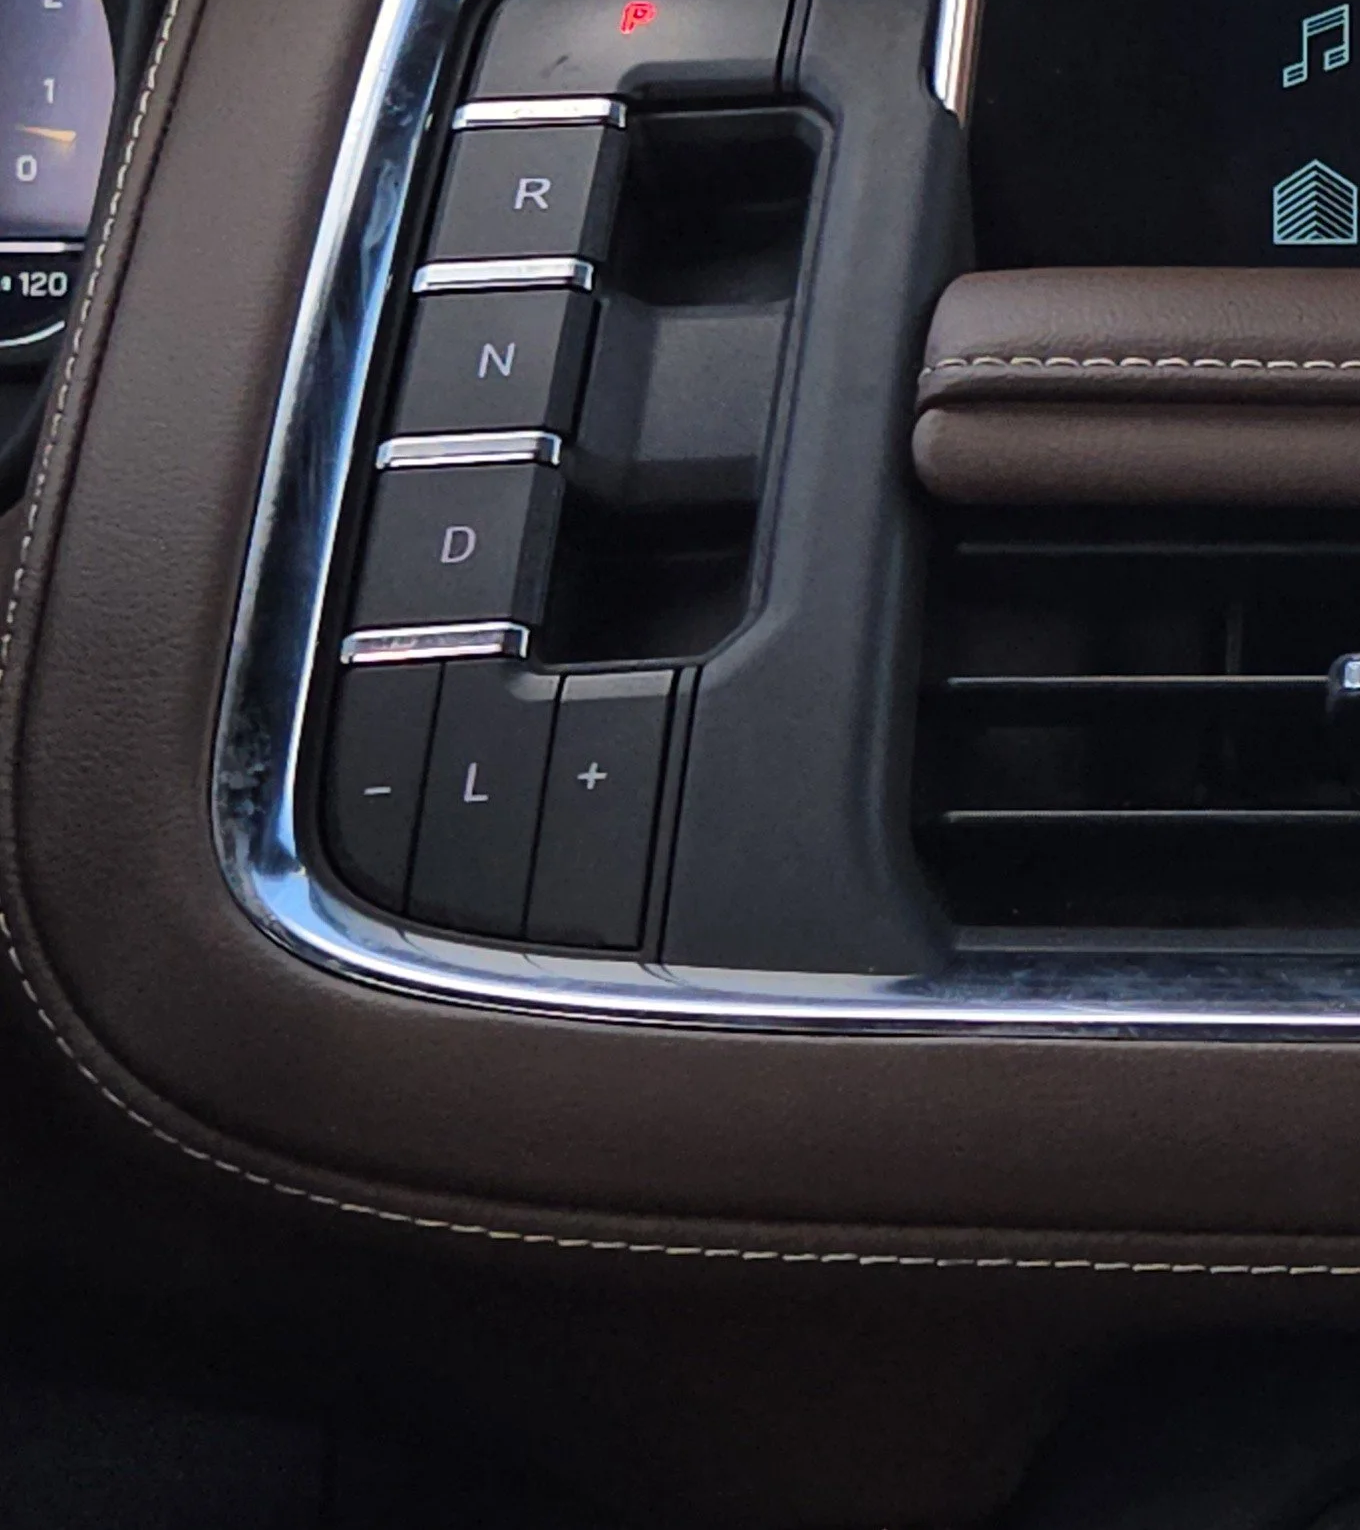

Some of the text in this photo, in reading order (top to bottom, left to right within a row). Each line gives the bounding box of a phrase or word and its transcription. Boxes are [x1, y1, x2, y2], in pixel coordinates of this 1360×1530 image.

[618, 0, 658, 35] P
[43, 78, 55, 104] 1
[16, 155, 38, 182] 0
[514, 178, 551, 210] R
[18, 271, 68, 297] 120
[478, 342, 516, 378] N
[440, 526, 476, 564] D
[463, 762, 489, 803] L
